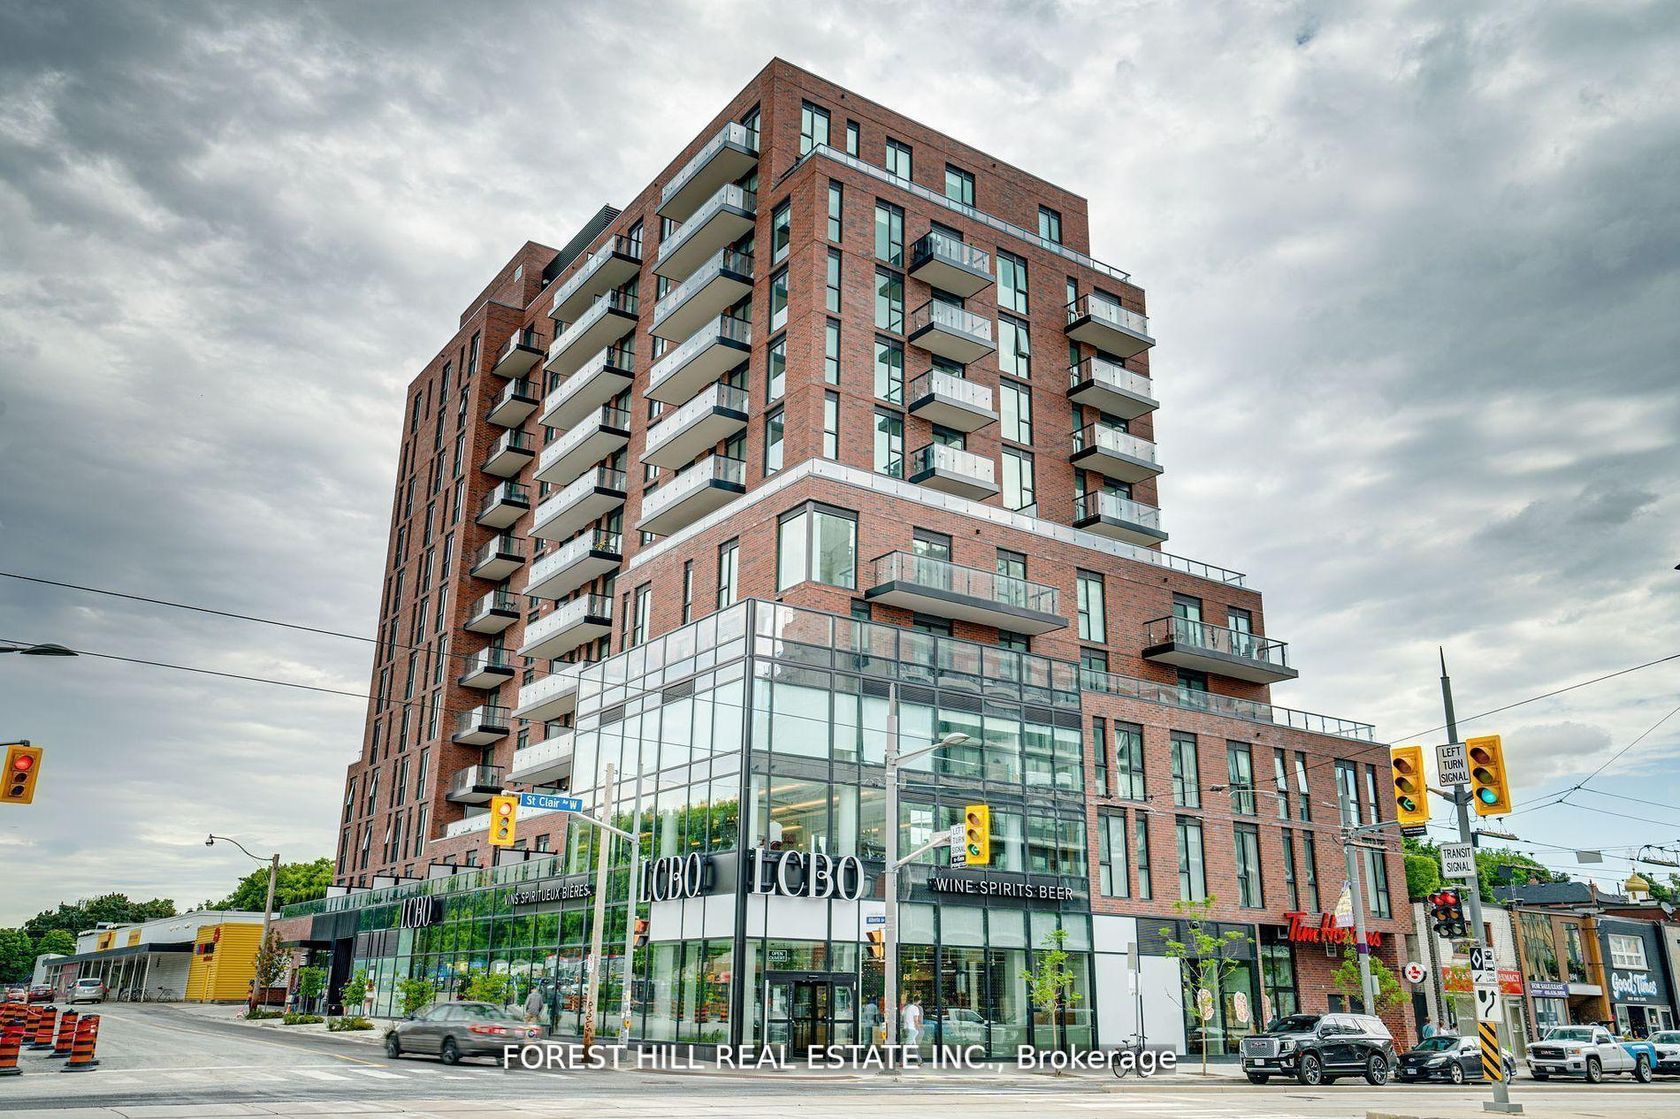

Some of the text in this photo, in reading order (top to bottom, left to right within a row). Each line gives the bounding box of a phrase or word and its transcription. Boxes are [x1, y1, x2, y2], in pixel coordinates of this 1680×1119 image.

[1442, 747, 1460, 757] LEFT
[1443, 759, 1464, 770] TURN
[1441, 772, 1468, 783] SIGNAL
[526, 795, 535, 805] St
[539, 796, 559, 808] Clair
[569, 800, 577, 809] W
[1443, 847, 1471, 859] TRANSIT
[752, 848, 865, 900] LCBO
[1446, 861, 1471, 872] SIGNAL
[640, 852, 701, 902] LCBO
[936, 877, 1073, 900] WINE SPIRITS BEER
[520, 889, 560, 904] SPIRITUEUX
[400, 895, 432, 928] LCBO
[1284, 912, 1319, 943] Tim
[1611, 971, 1657, 1000] Good Times
